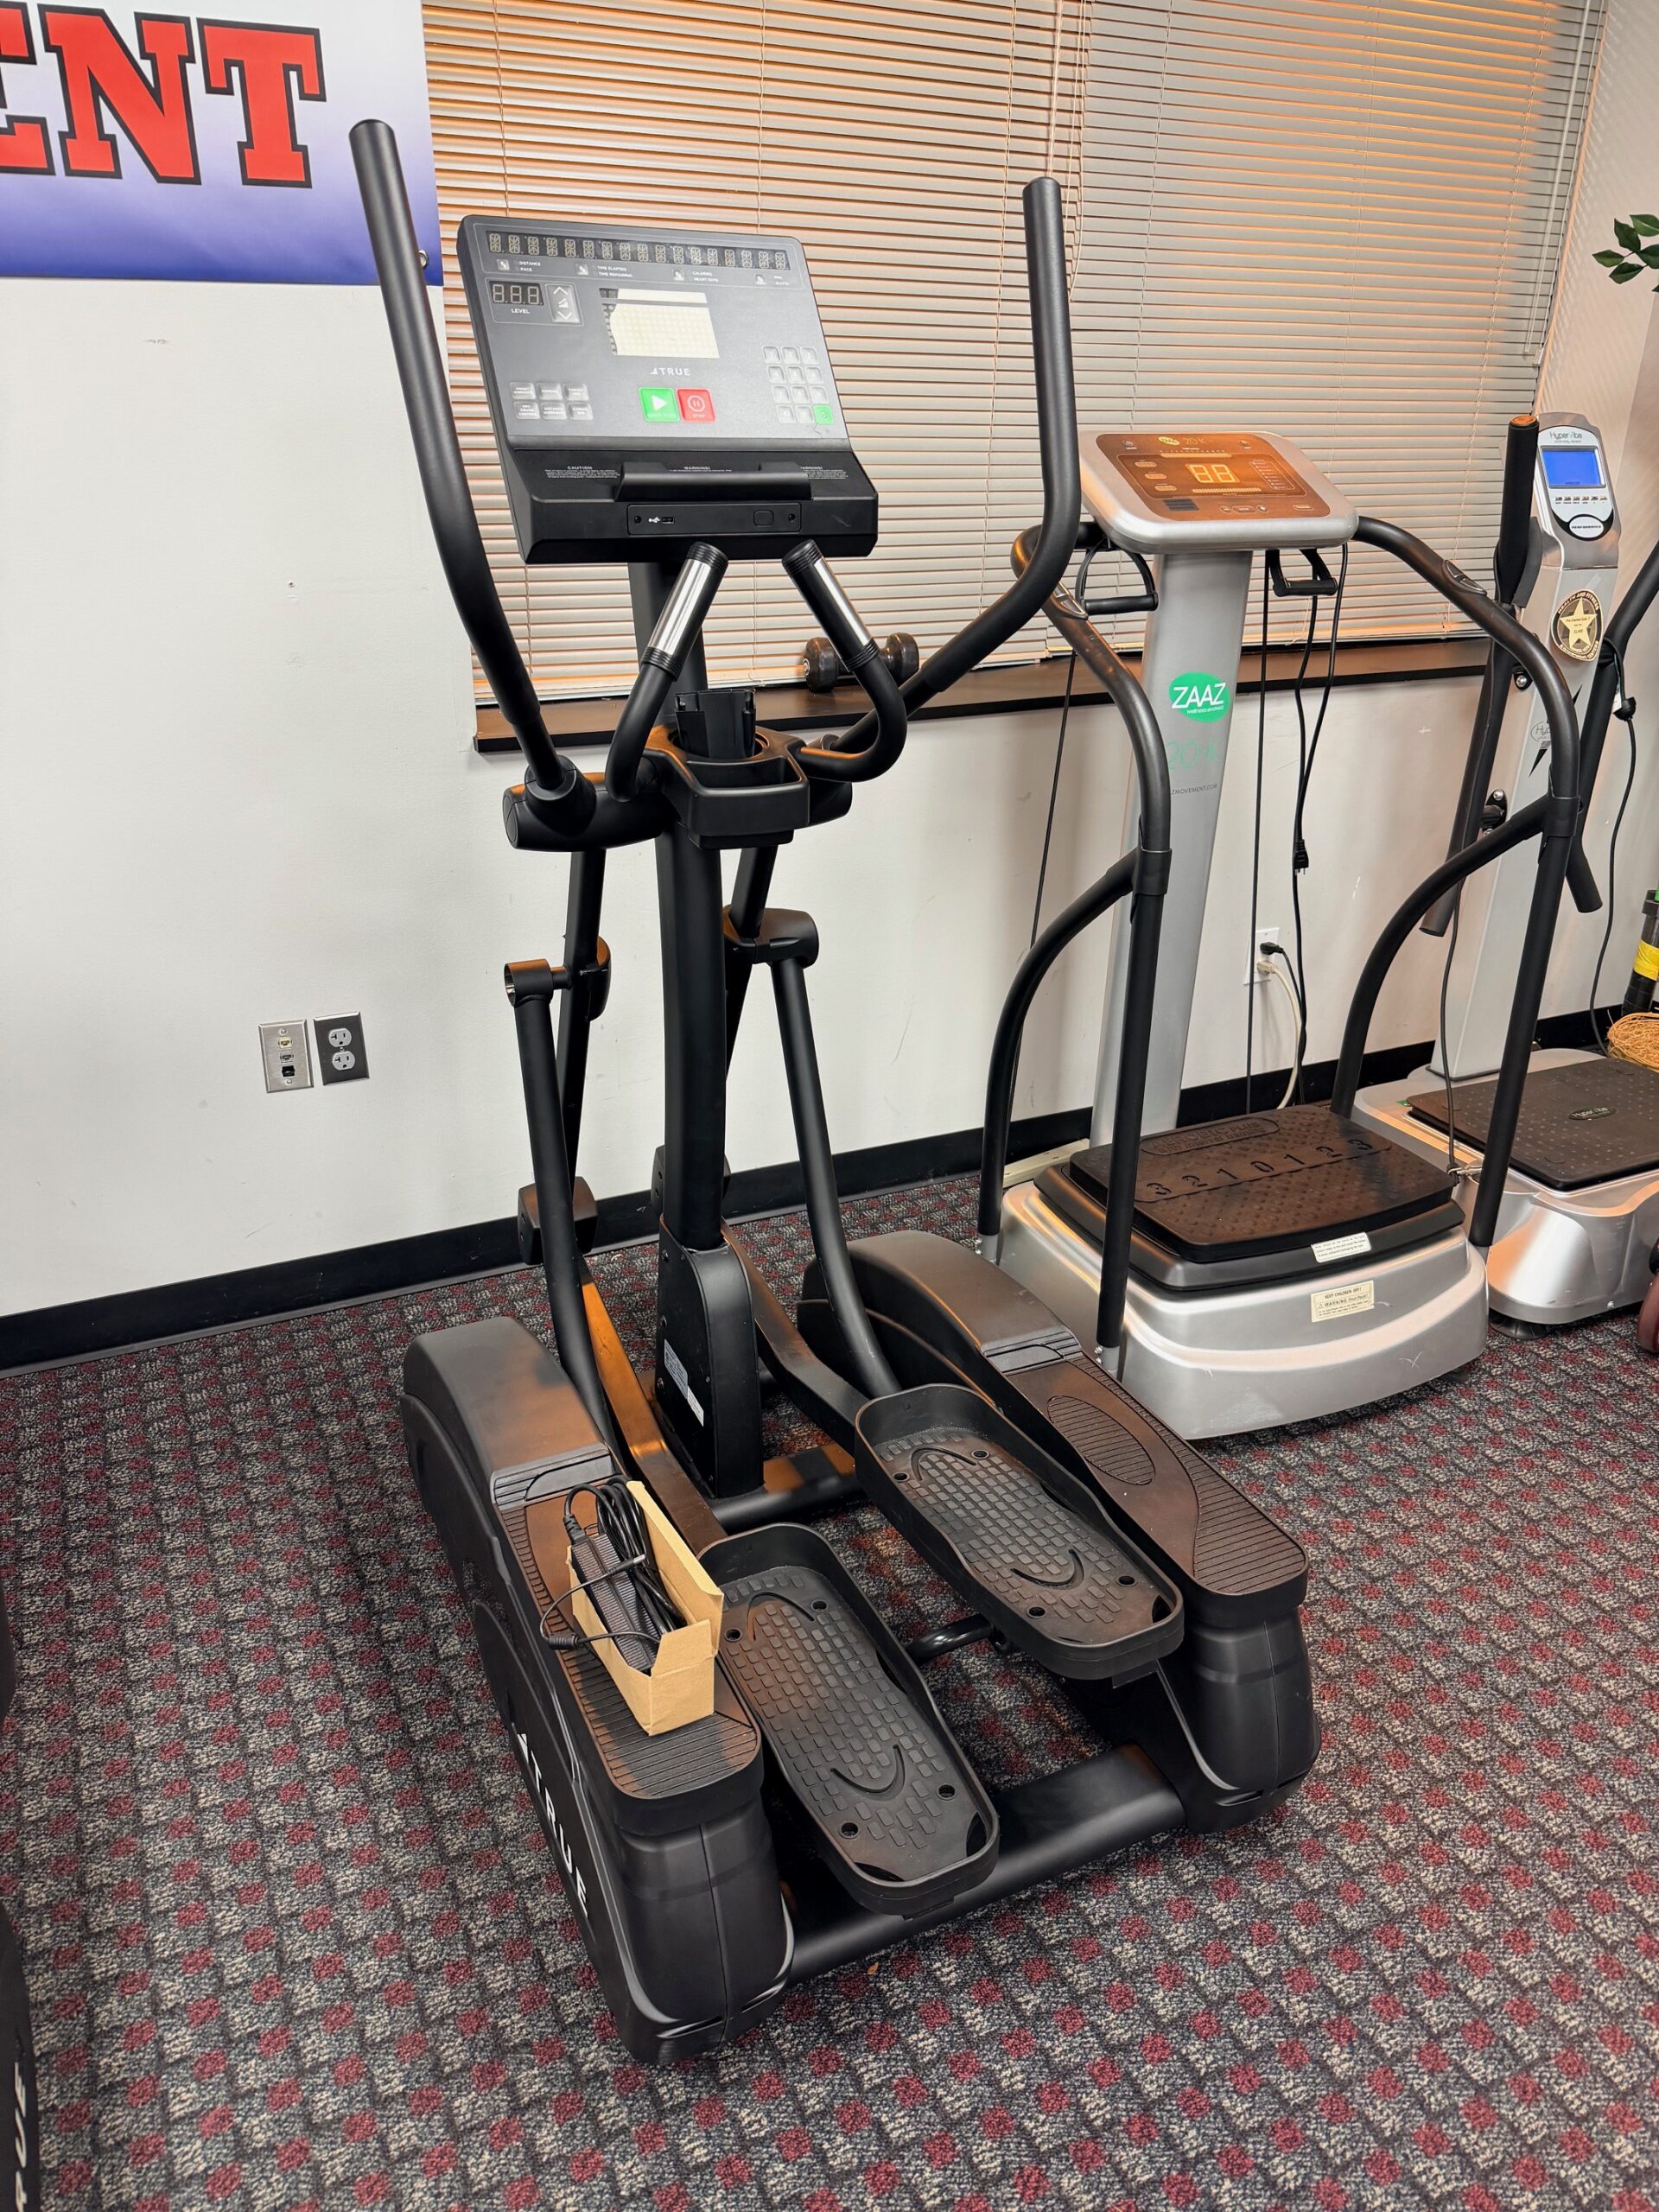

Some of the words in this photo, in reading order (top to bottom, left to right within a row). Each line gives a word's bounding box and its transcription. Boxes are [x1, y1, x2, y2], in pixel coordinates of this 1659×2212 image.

[658, 367, 691, 376] TRUE
[1172, 683, 1226, 709] ZAAZ
[1146, 1182, 1173, 1195] 3
[1181, 1174, 1209, 1187] 2
[1216, 1168, 1238, 1180] 1
[1250, 1160, 1274, 1173] 0
[1284, 1154, 1306, 1165] 1
[1316, 1146, 1343, 1158] 2
[1348, 1139, 1373, 1151] 3
[1324, 1298, 1347, 1307] WARNING
[531, 1750, 588, 1917] TRUE
